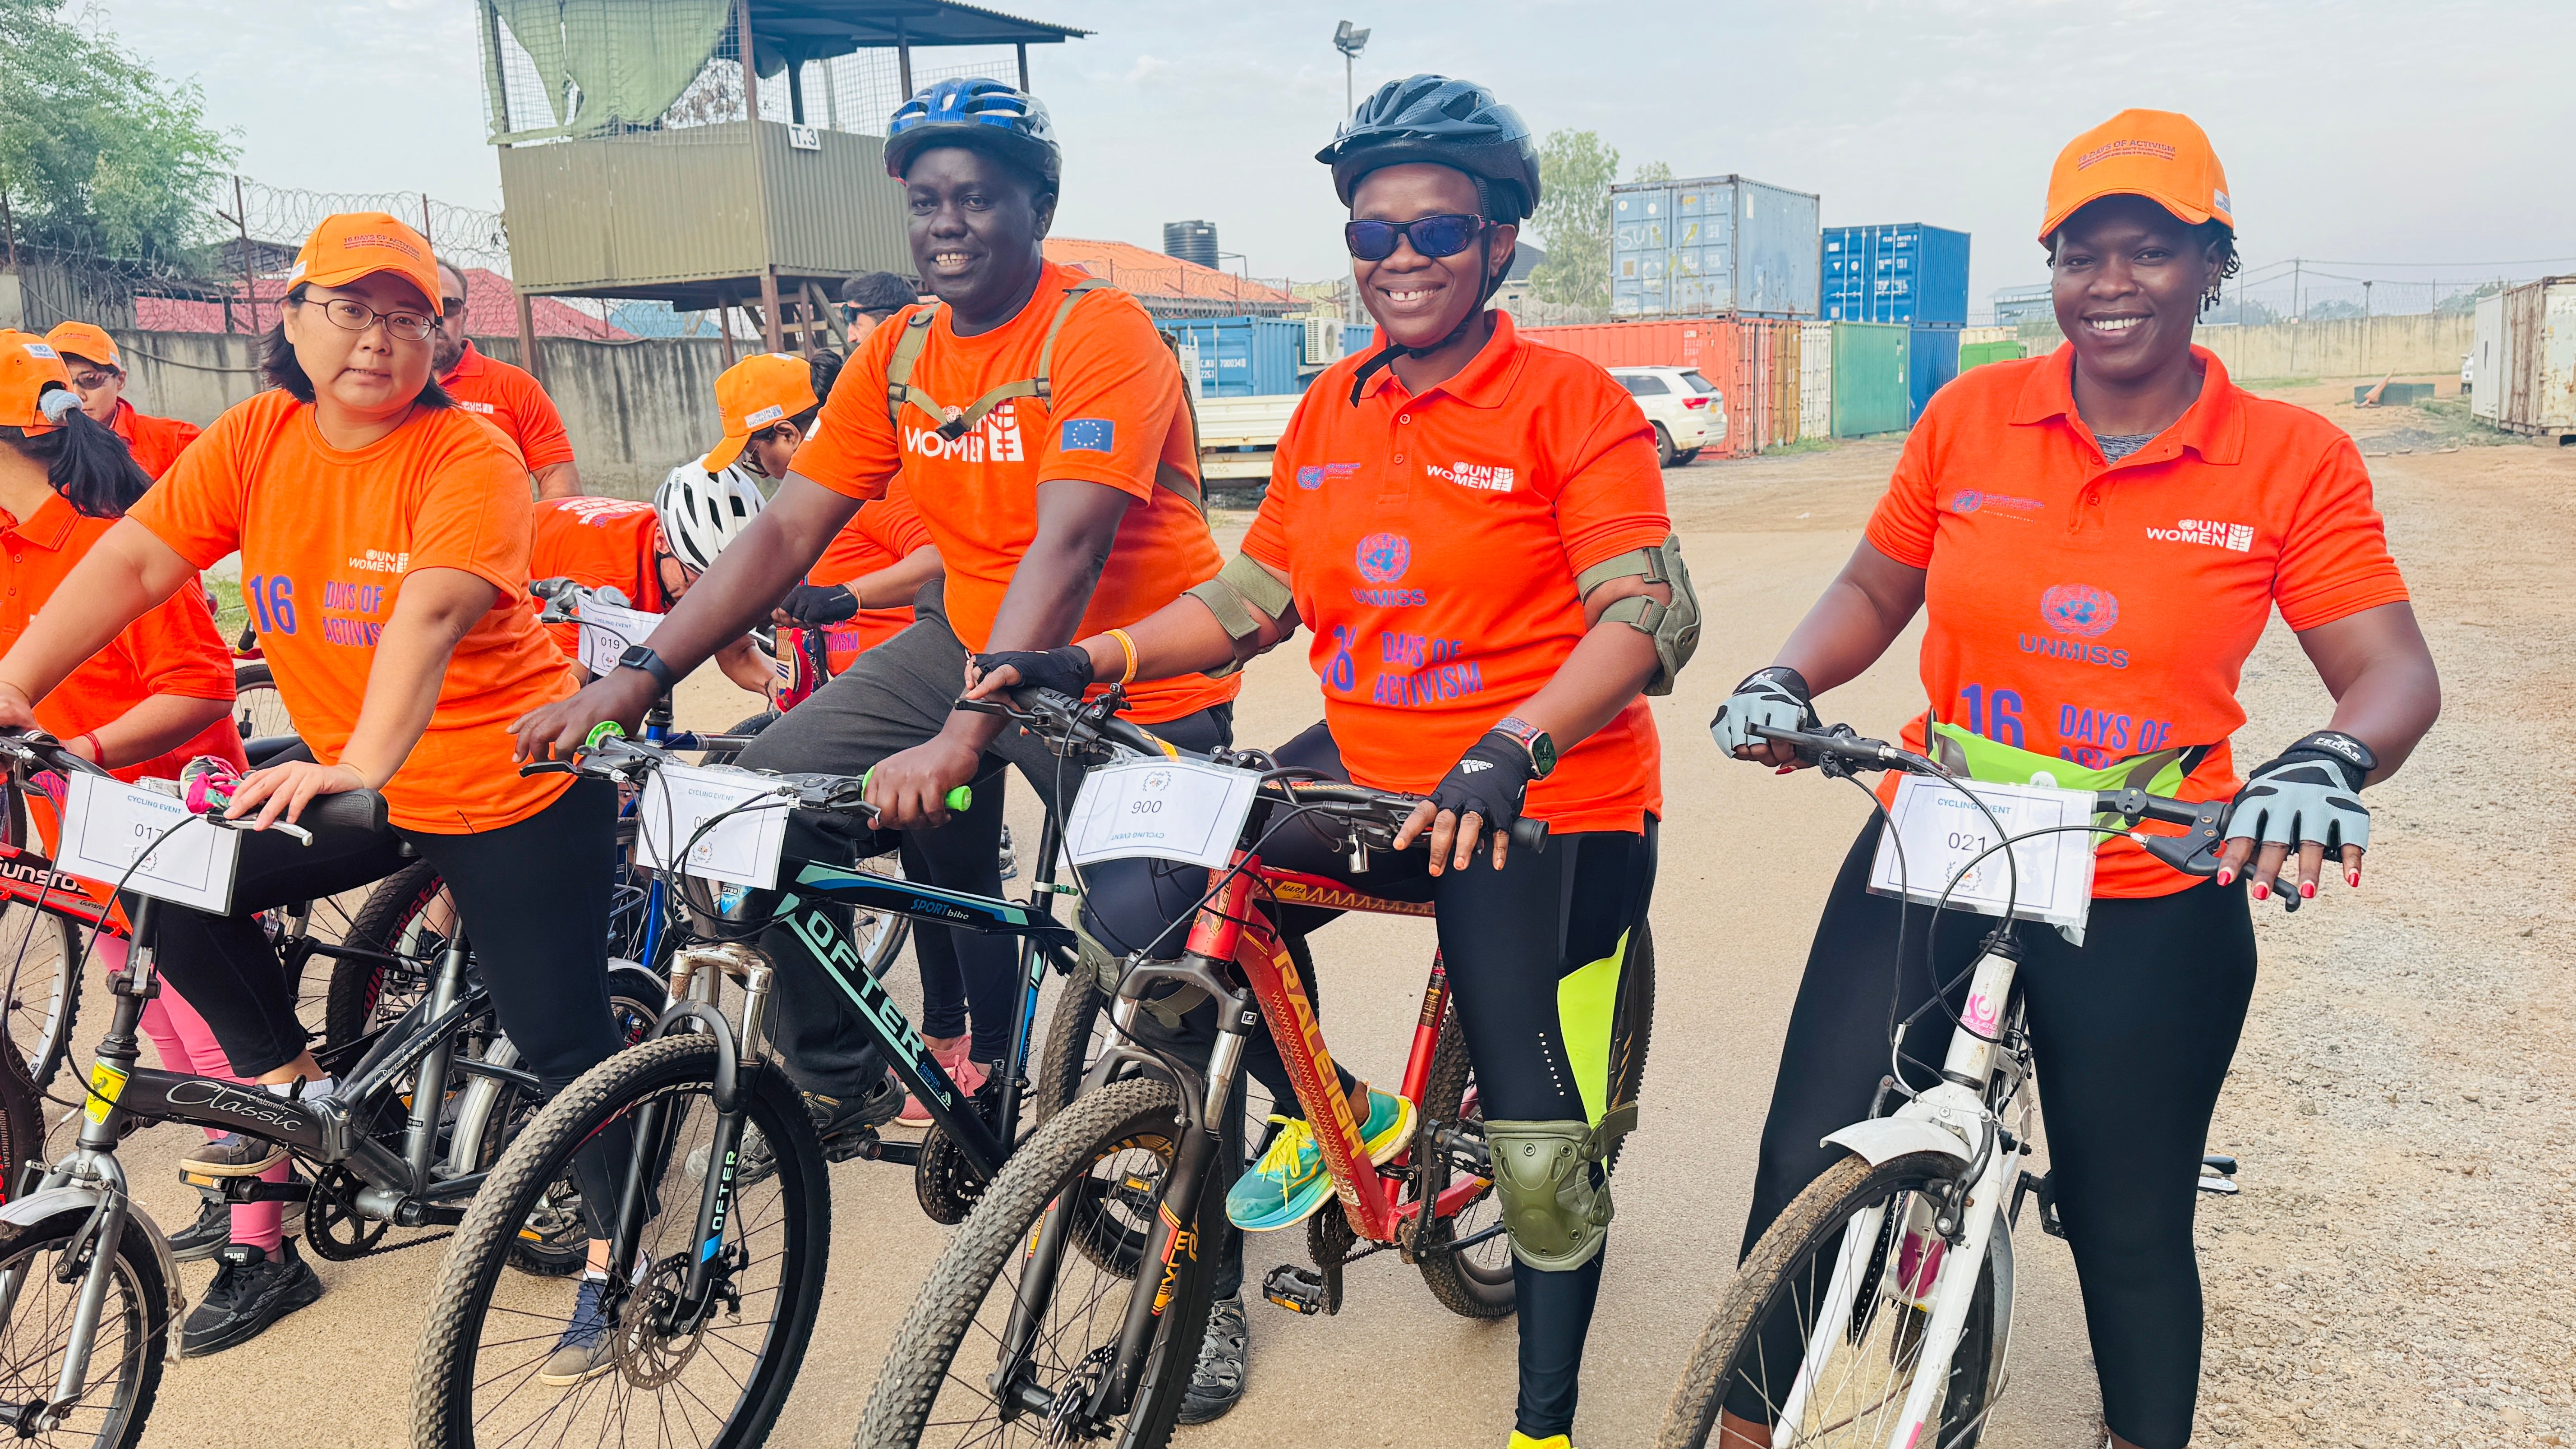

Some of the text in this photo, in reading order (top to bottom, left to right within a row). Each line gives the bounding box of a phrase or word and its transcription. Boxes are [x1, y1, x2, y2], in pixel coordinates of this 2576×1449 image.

[791, 127, 817, 146] T.3
[2129, 140, 2176, 152] ACTIVISM
[1426, 465, 1491, 490] WOMEN
[1469, 465, 1491, 478] UN
[2146, 527, 2226, 547] WOMEN
[2198, 519, 2227, 535] UN
[349, 557, 398, 573] WOMEN
[377, 552, 396, 562] UN
[250, 574, 385, 635] 16 DAYS OF
[1351, 586, 1427, 607] UNMISS
[322, 616, 386, 648] ACTIVIS
[600, 636, 620, 650] 019
[2019, 633, 2130, 669] UNMISS
[1373, 662, 1483, 706] ACTIVISM
[1960, 683, 2172, 754] 16 DAYS OF
[127, 794, 182, 814] CYCLING EVENT
[688, 788, 735, 801] CYCLING EVENT
[1937, 798, 1978, 810] CYCLING
[134, 823, 164, 841] 017
[1948, 832, 1988, 854] 021
[1280, 884, 1306, 894] MARA
[911, 898, 969, 920] SPORT bike
[807, 911, 925, 1063] OFTER
[1273, 950, 1365, 1160] RALEIGH
[166, 1081, 303, 1132] Classic
[712, 1150, 736, 1230] OFTER
